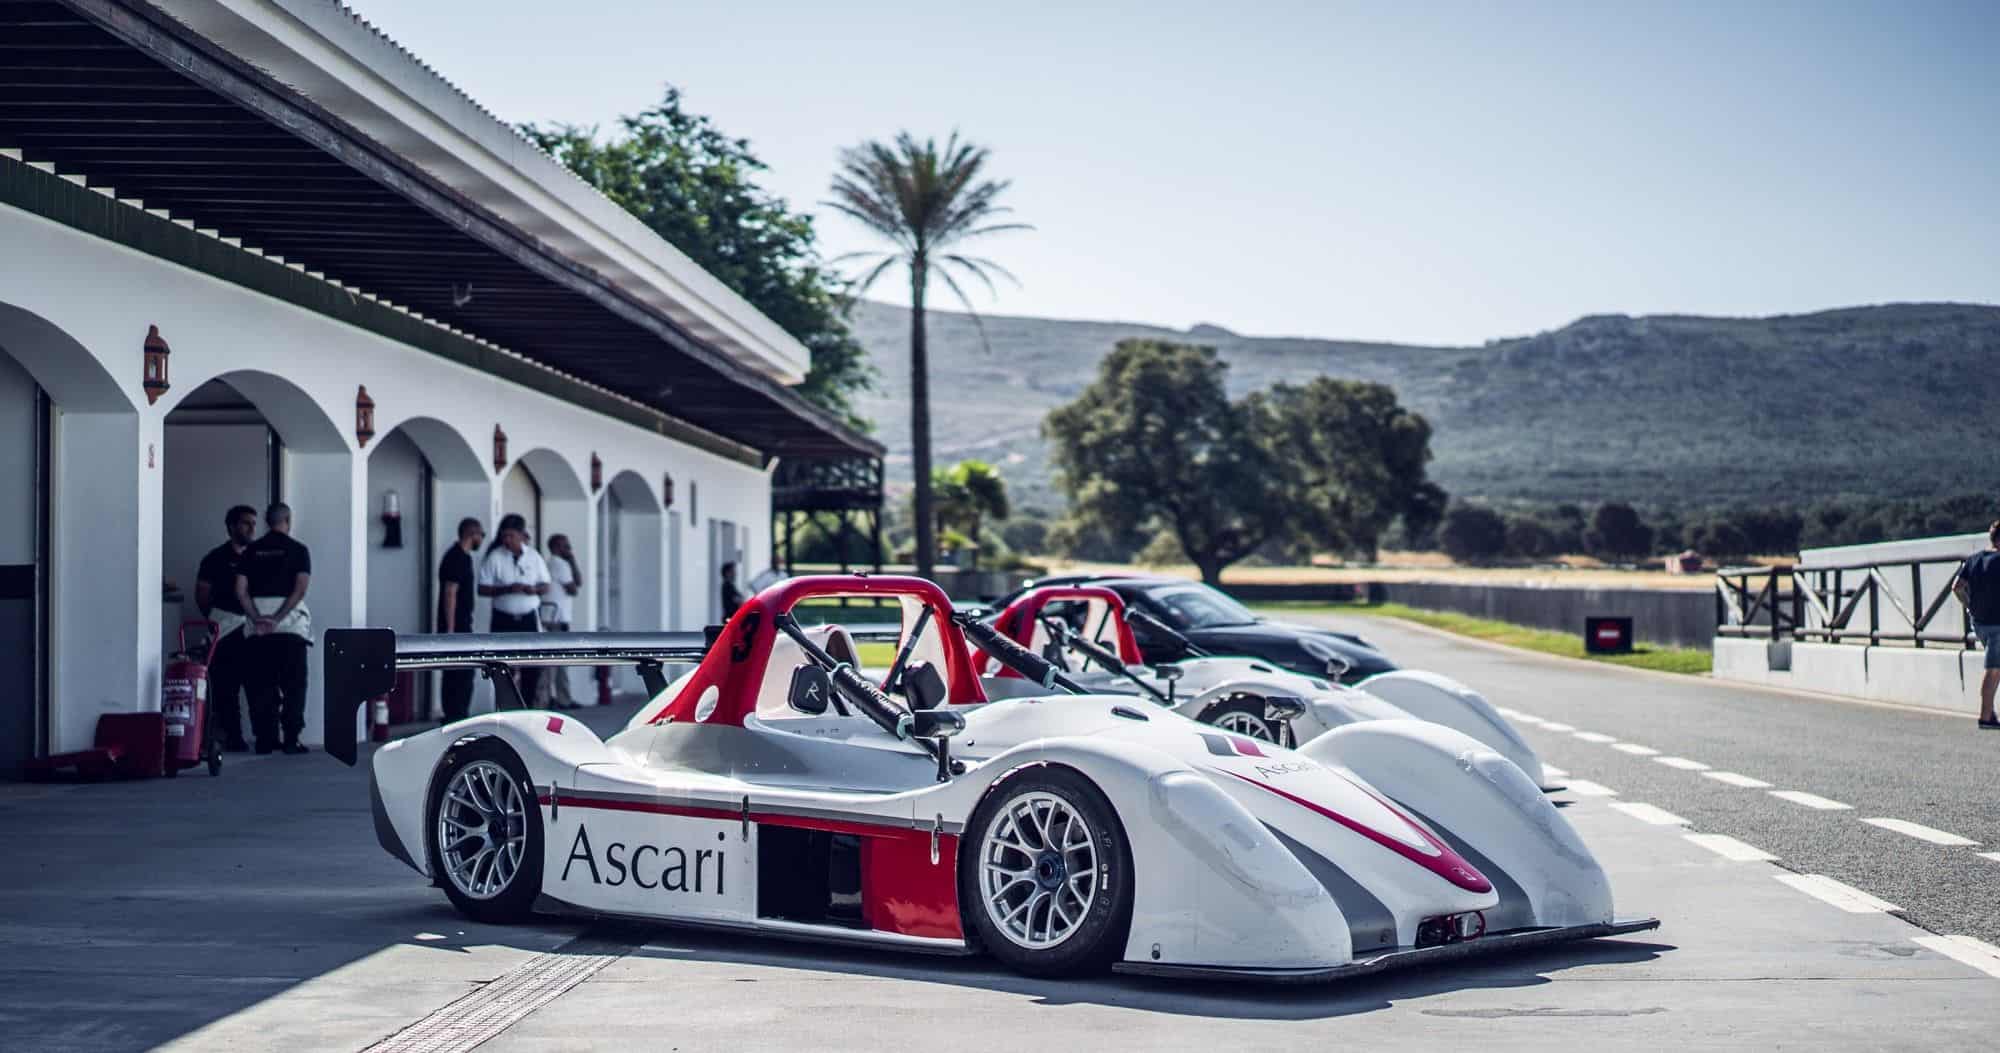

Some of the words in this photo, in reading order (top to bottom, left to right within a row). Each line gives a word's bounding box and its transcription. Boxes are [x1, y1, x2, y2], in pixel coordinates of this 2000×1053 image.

[804, 681, 820, 701] R
[1254, 760, 1315, 779] Asca
[561, 823, 726, 895] Ascari
